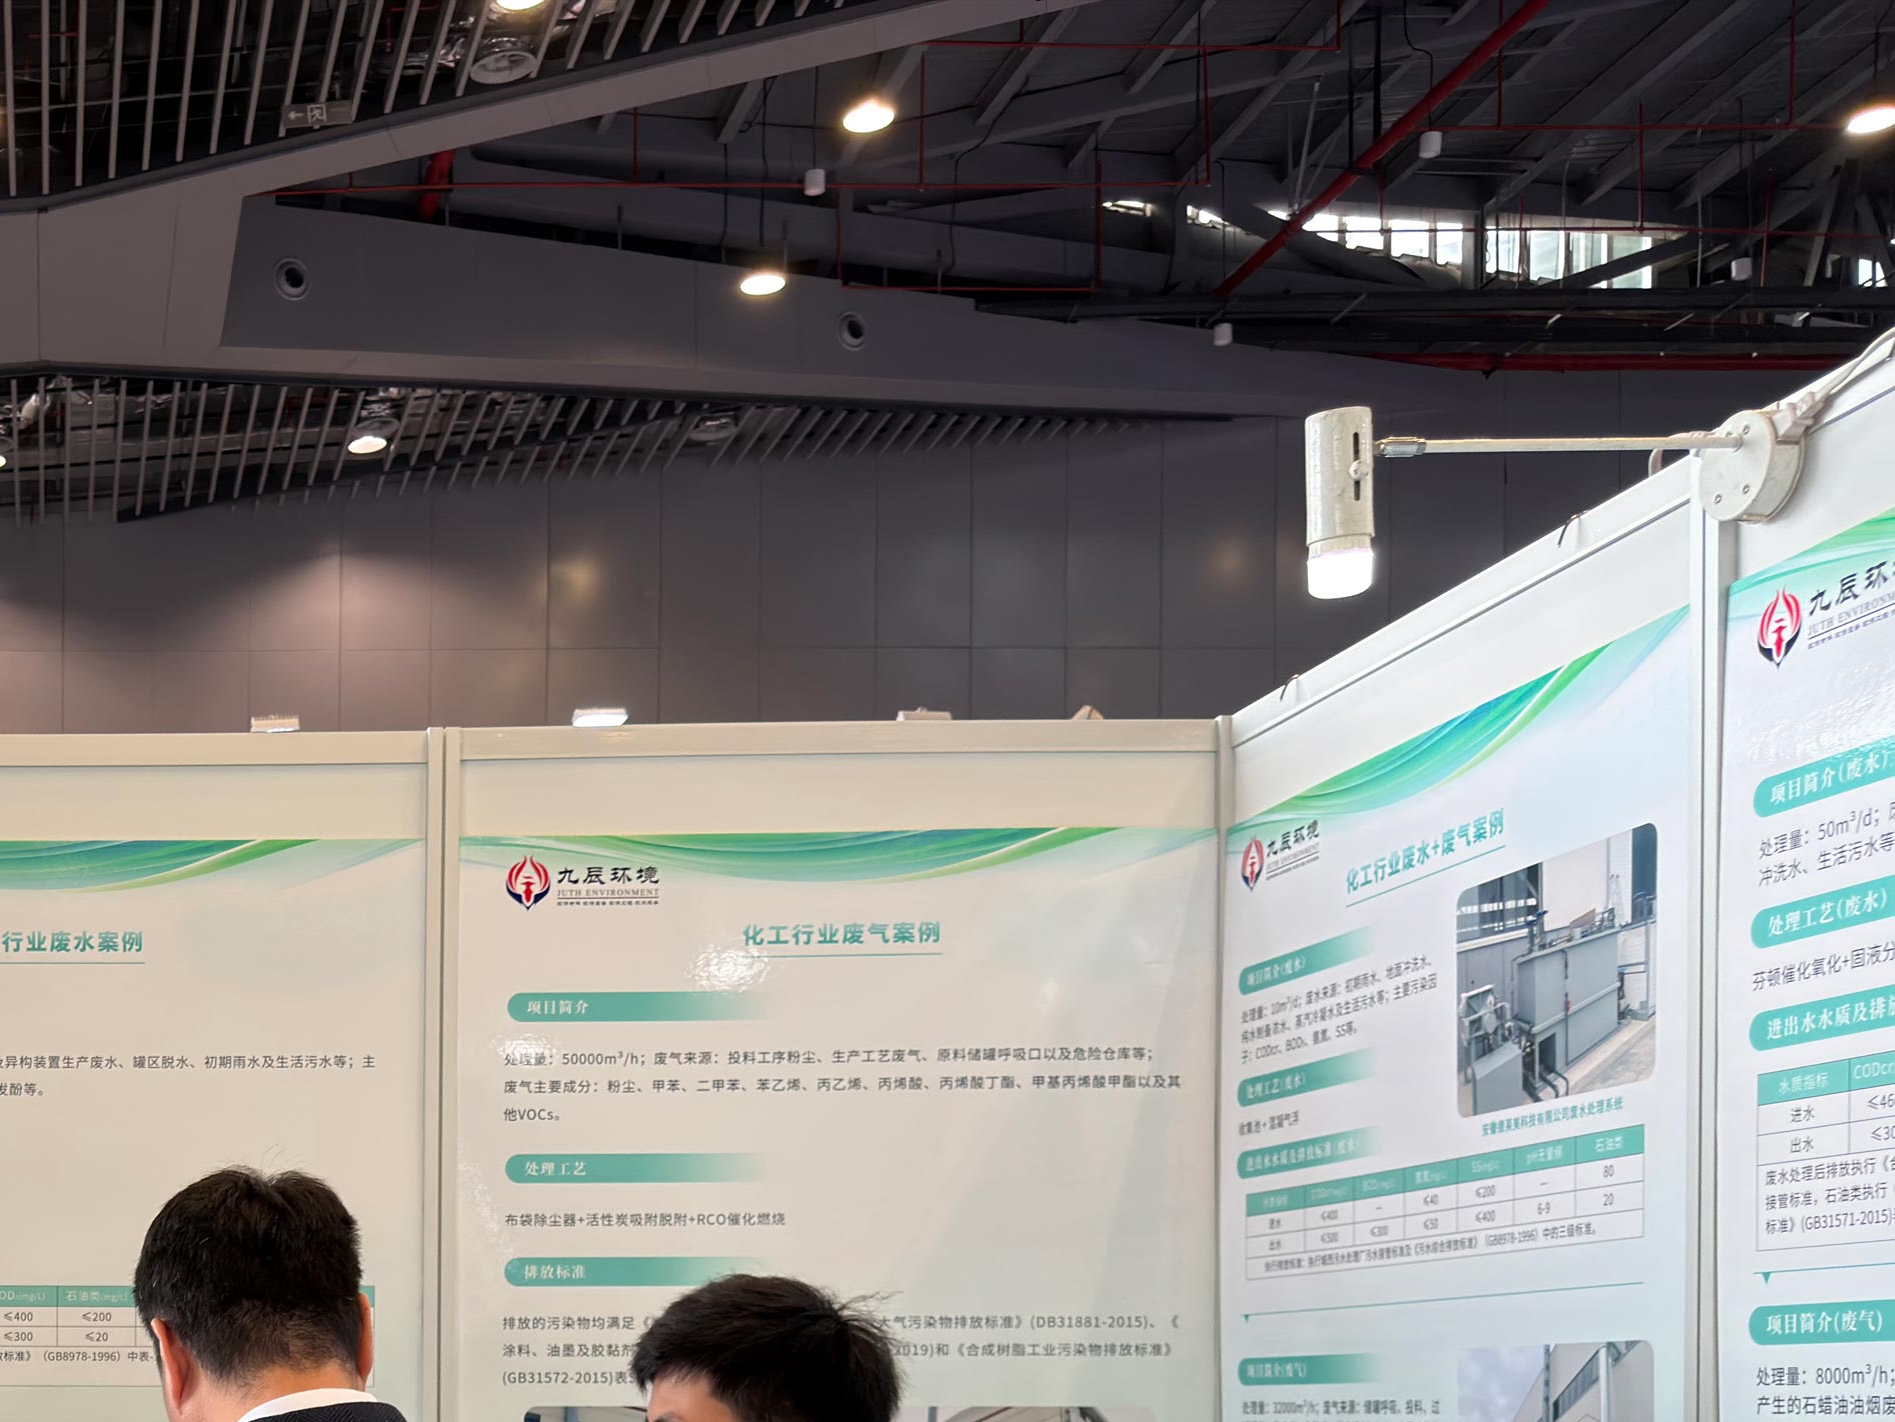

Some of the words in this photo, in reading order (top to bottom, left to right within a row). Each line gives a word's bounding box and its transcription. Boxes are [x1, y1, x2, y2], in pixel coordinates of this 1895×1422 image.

[1808, 560, 1895, 617] 九辰环
[1769, 750, 1888, 806] 项目简介(废水)
[1266, 820, 1320, 858] 九辰环境
[1345, 808, 1505, 894] 化工行业废水+废气案例
[556, 866, 660, 885] 九辰环境
[557, 889, 583, 897] JUTH
[585, 889, 660, 897] ENVIRONMENT
[1768, 887, 1888, 938] 处理工艺(废水)
[742, 921, 941, 946] 化工行业废气案例
[526, 999, 590, 1015] 项目简介
[1778, 1072, 1829, 1095] 水质指标
[503, 1107, 560, 1122] 他VOCs。
[1790, 1105, 1815, 1124] 进水
[1790, 1136, 1815, 1154] 出水
[524, 1161, 587, 1176] 处理工艺
[504, 1213, 786, 1228] 布袋除尘器+活性炭吸附脱附+RCO催化燃烧
[524, 1264, 586, 1280] 排放标准
[3, 1311, 34, 1322] ≤400
[81, 1311, 113, 1322] ≤200
[1766, 1309, 1883, 1335] 项目简介(废气)
[3, 1331, 34, 1342] ≤300
[84, 1331, 109, 1342] ≤20
